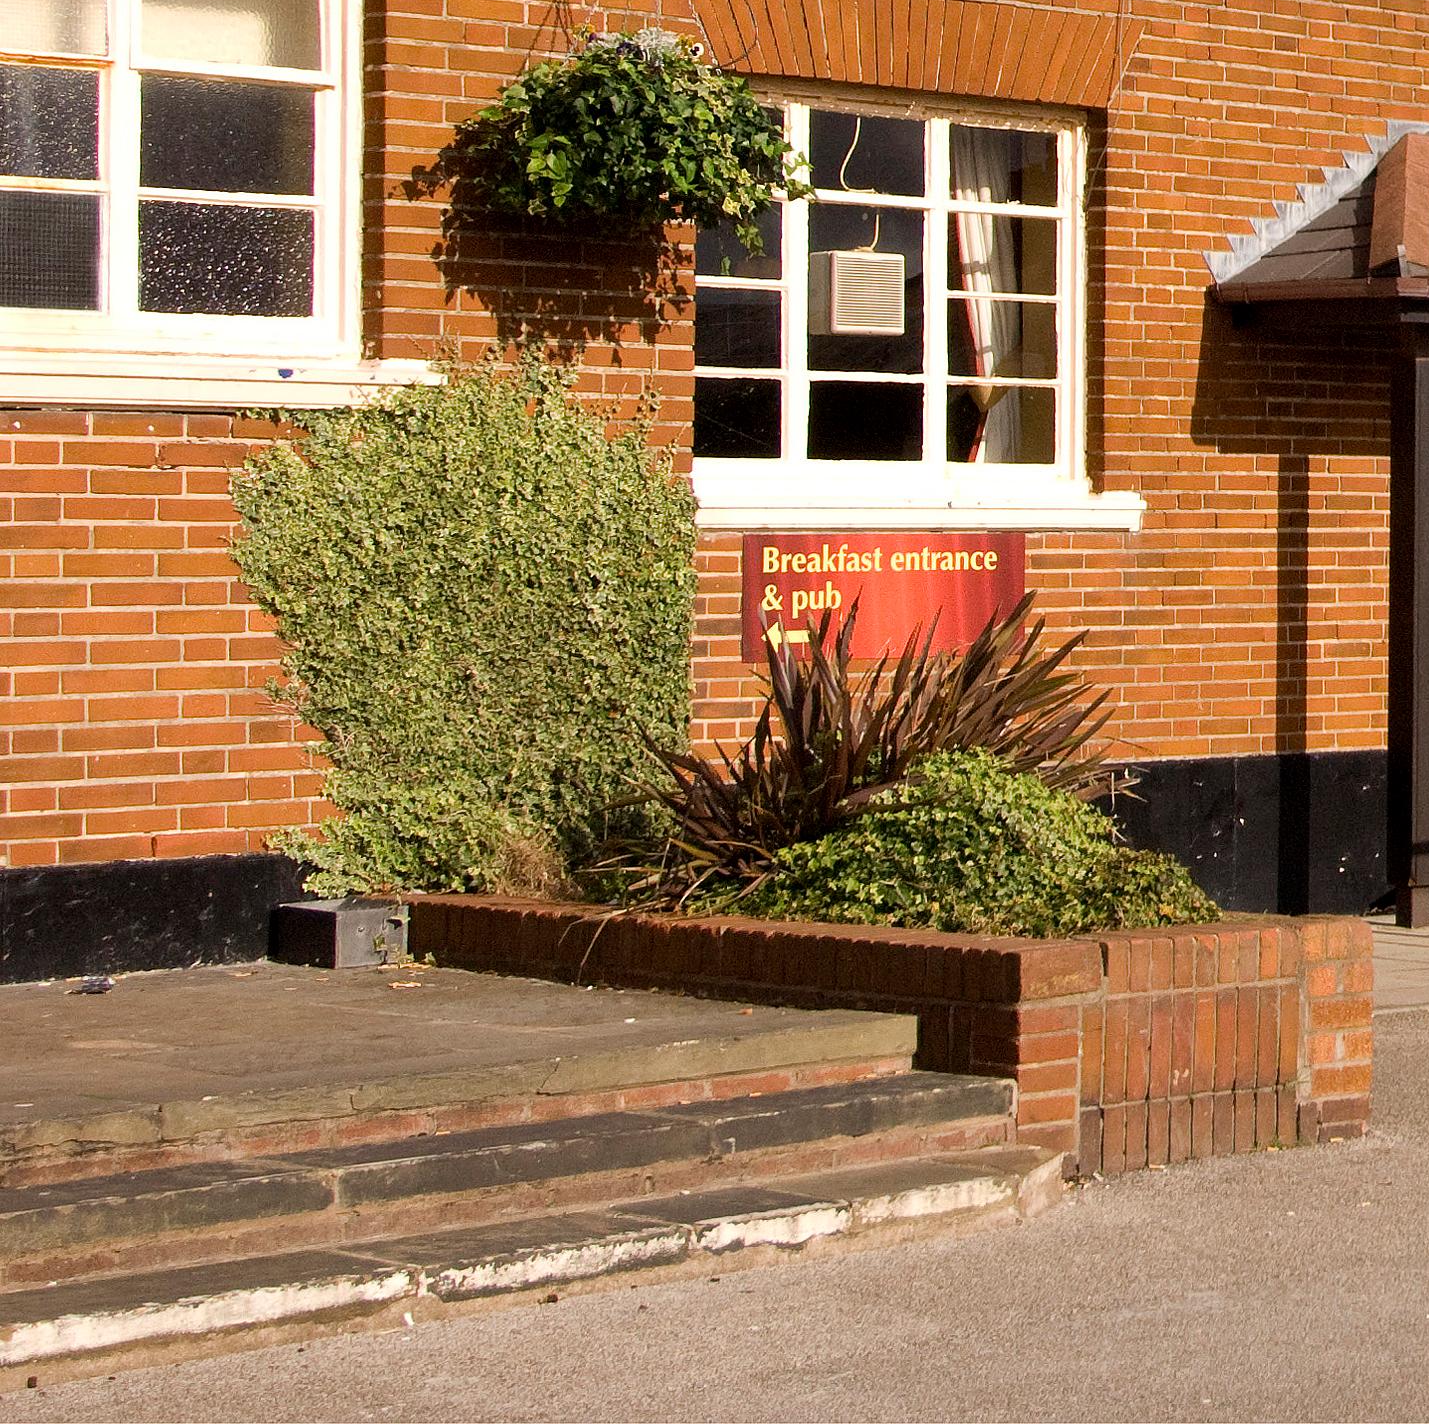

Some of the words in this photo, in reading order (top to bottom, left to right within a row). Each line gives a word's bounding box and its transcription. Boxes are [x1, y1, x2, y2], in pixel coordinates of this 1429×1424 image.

[762, 544, 882, 574] Breakfast
[890, 546, 998, 571] entrance
[761, 584, 783, 612] &
[792, 581, 842, 619] pub
